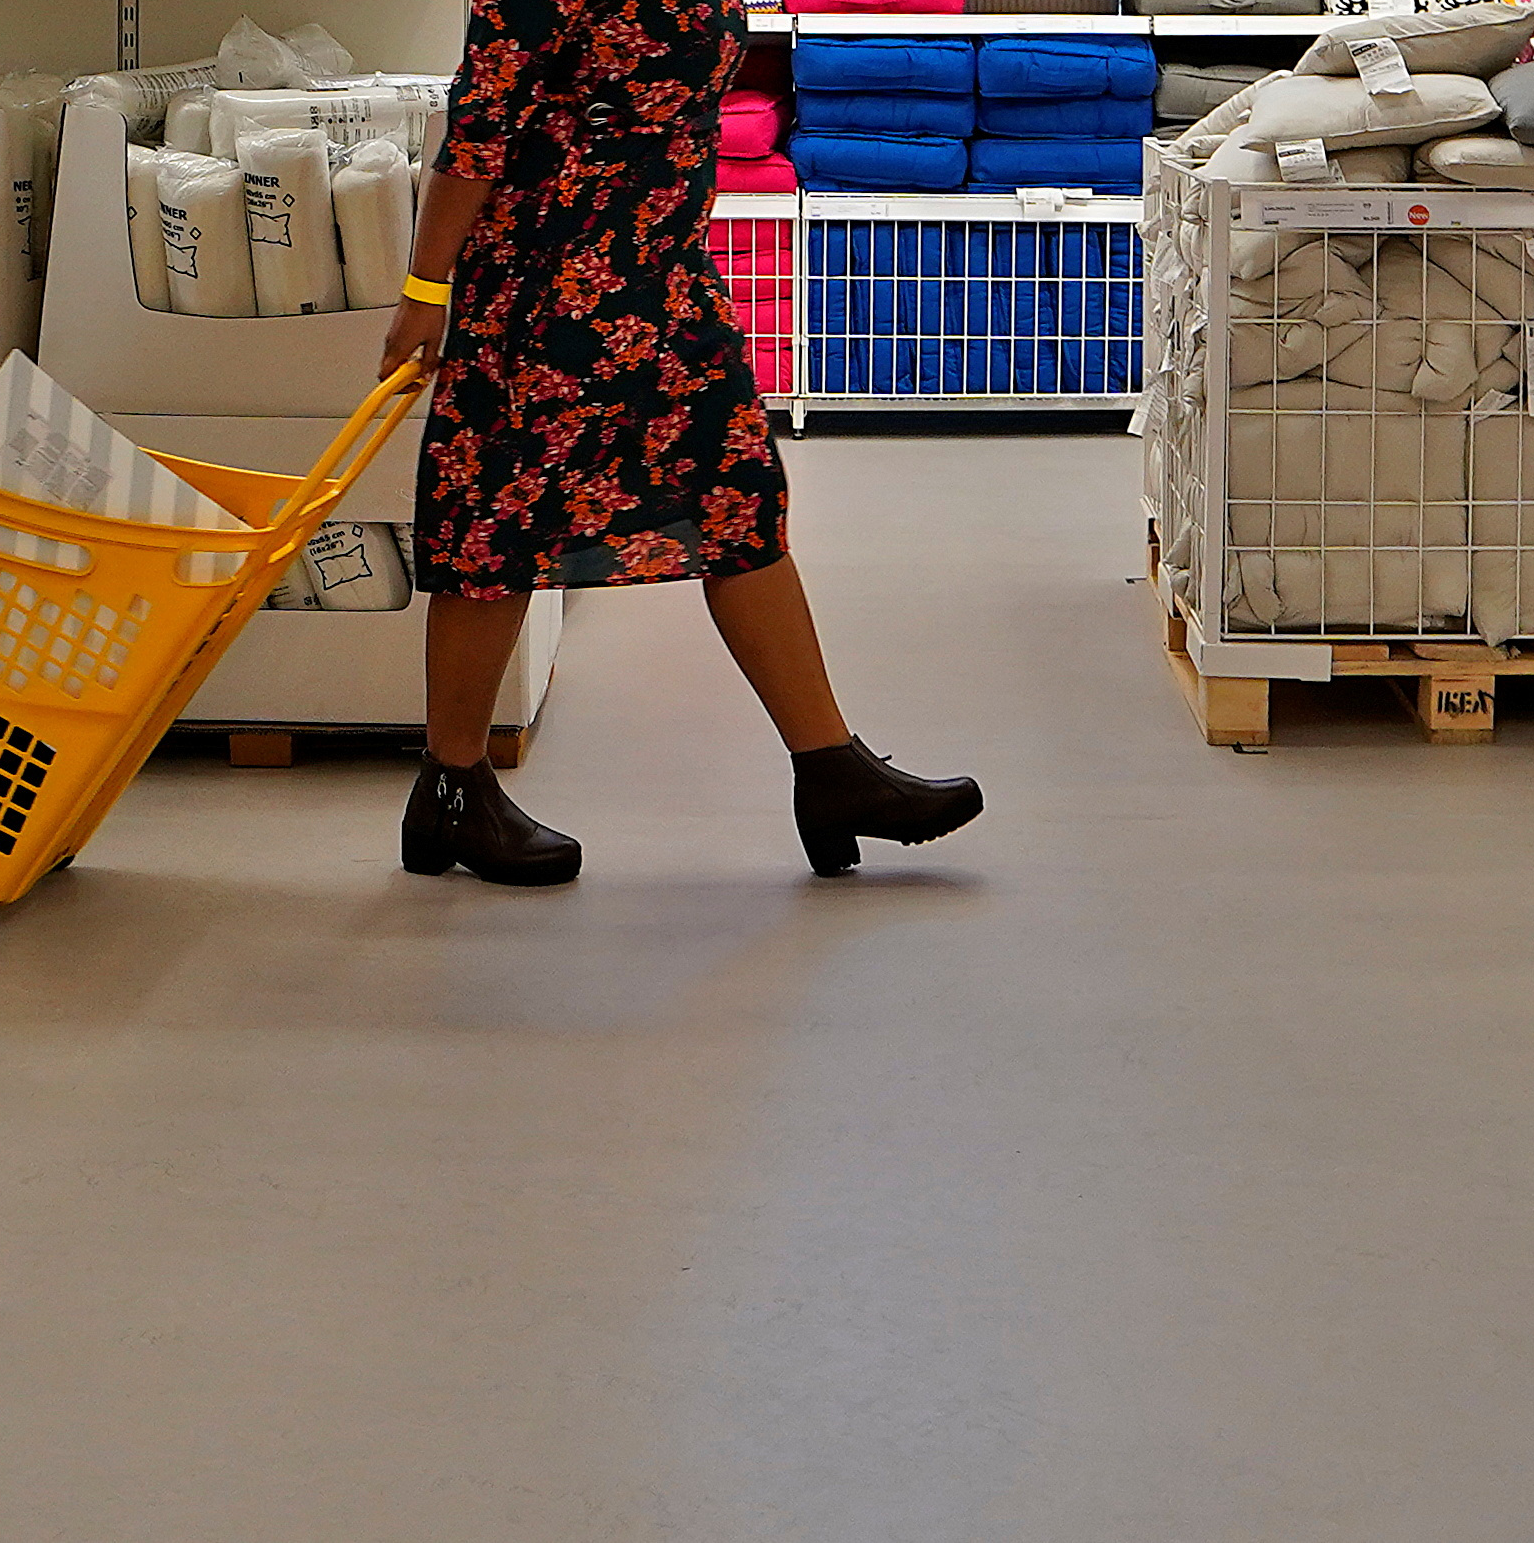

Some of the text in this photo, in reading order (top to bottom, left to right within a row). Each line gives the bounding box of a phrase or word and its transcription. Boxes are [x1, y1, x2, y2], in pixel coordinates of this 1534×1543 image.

[244, 172, 281, 189] INNER
[332, 530, 345, 539] cm
[1438, 689, 1488, 714] IKEA
